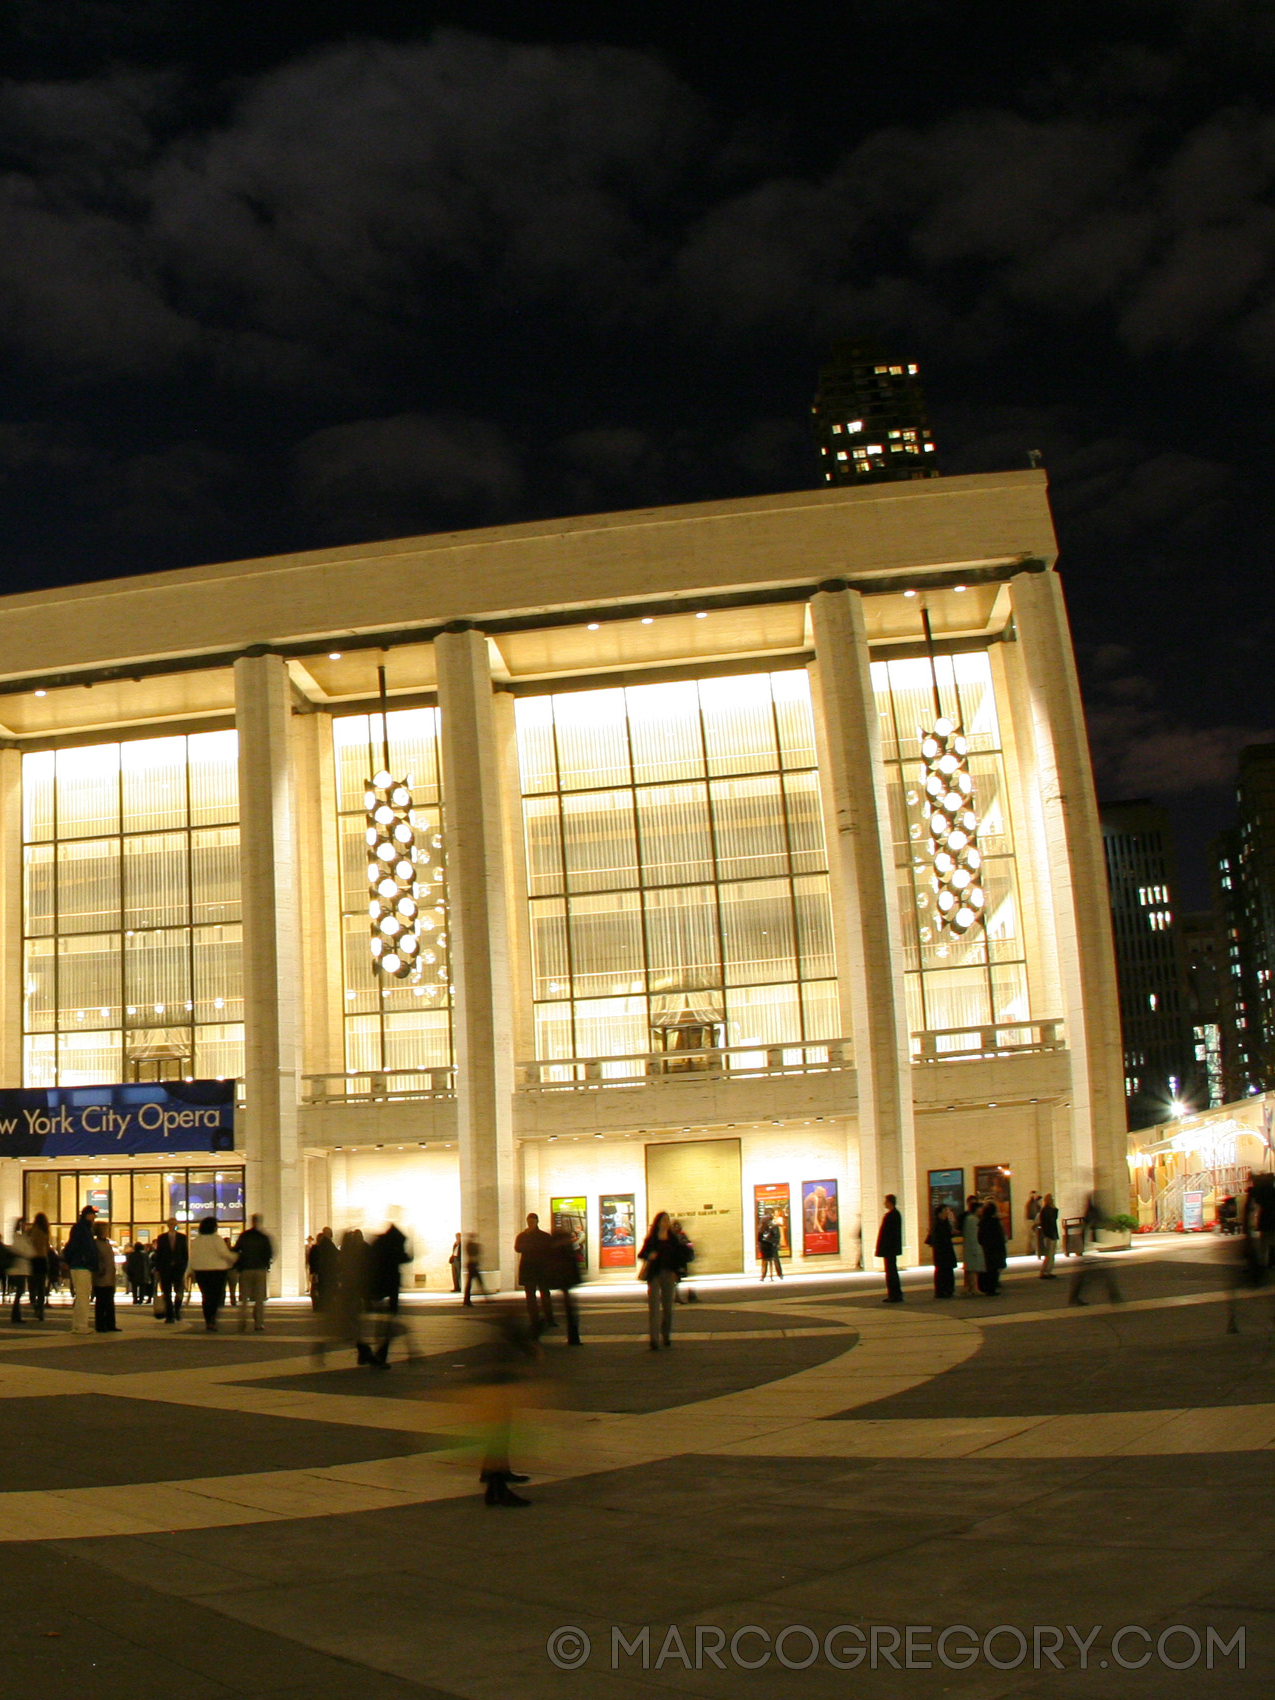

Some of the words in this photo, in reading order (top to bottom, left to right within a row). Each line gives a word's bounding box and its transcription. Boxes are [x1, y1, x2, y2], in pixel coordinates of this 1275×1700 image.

[23, 1104, 75, 1134] York
[81, 1105, 131, 1139] City
[137, 1102, 220, 1137] Opera
